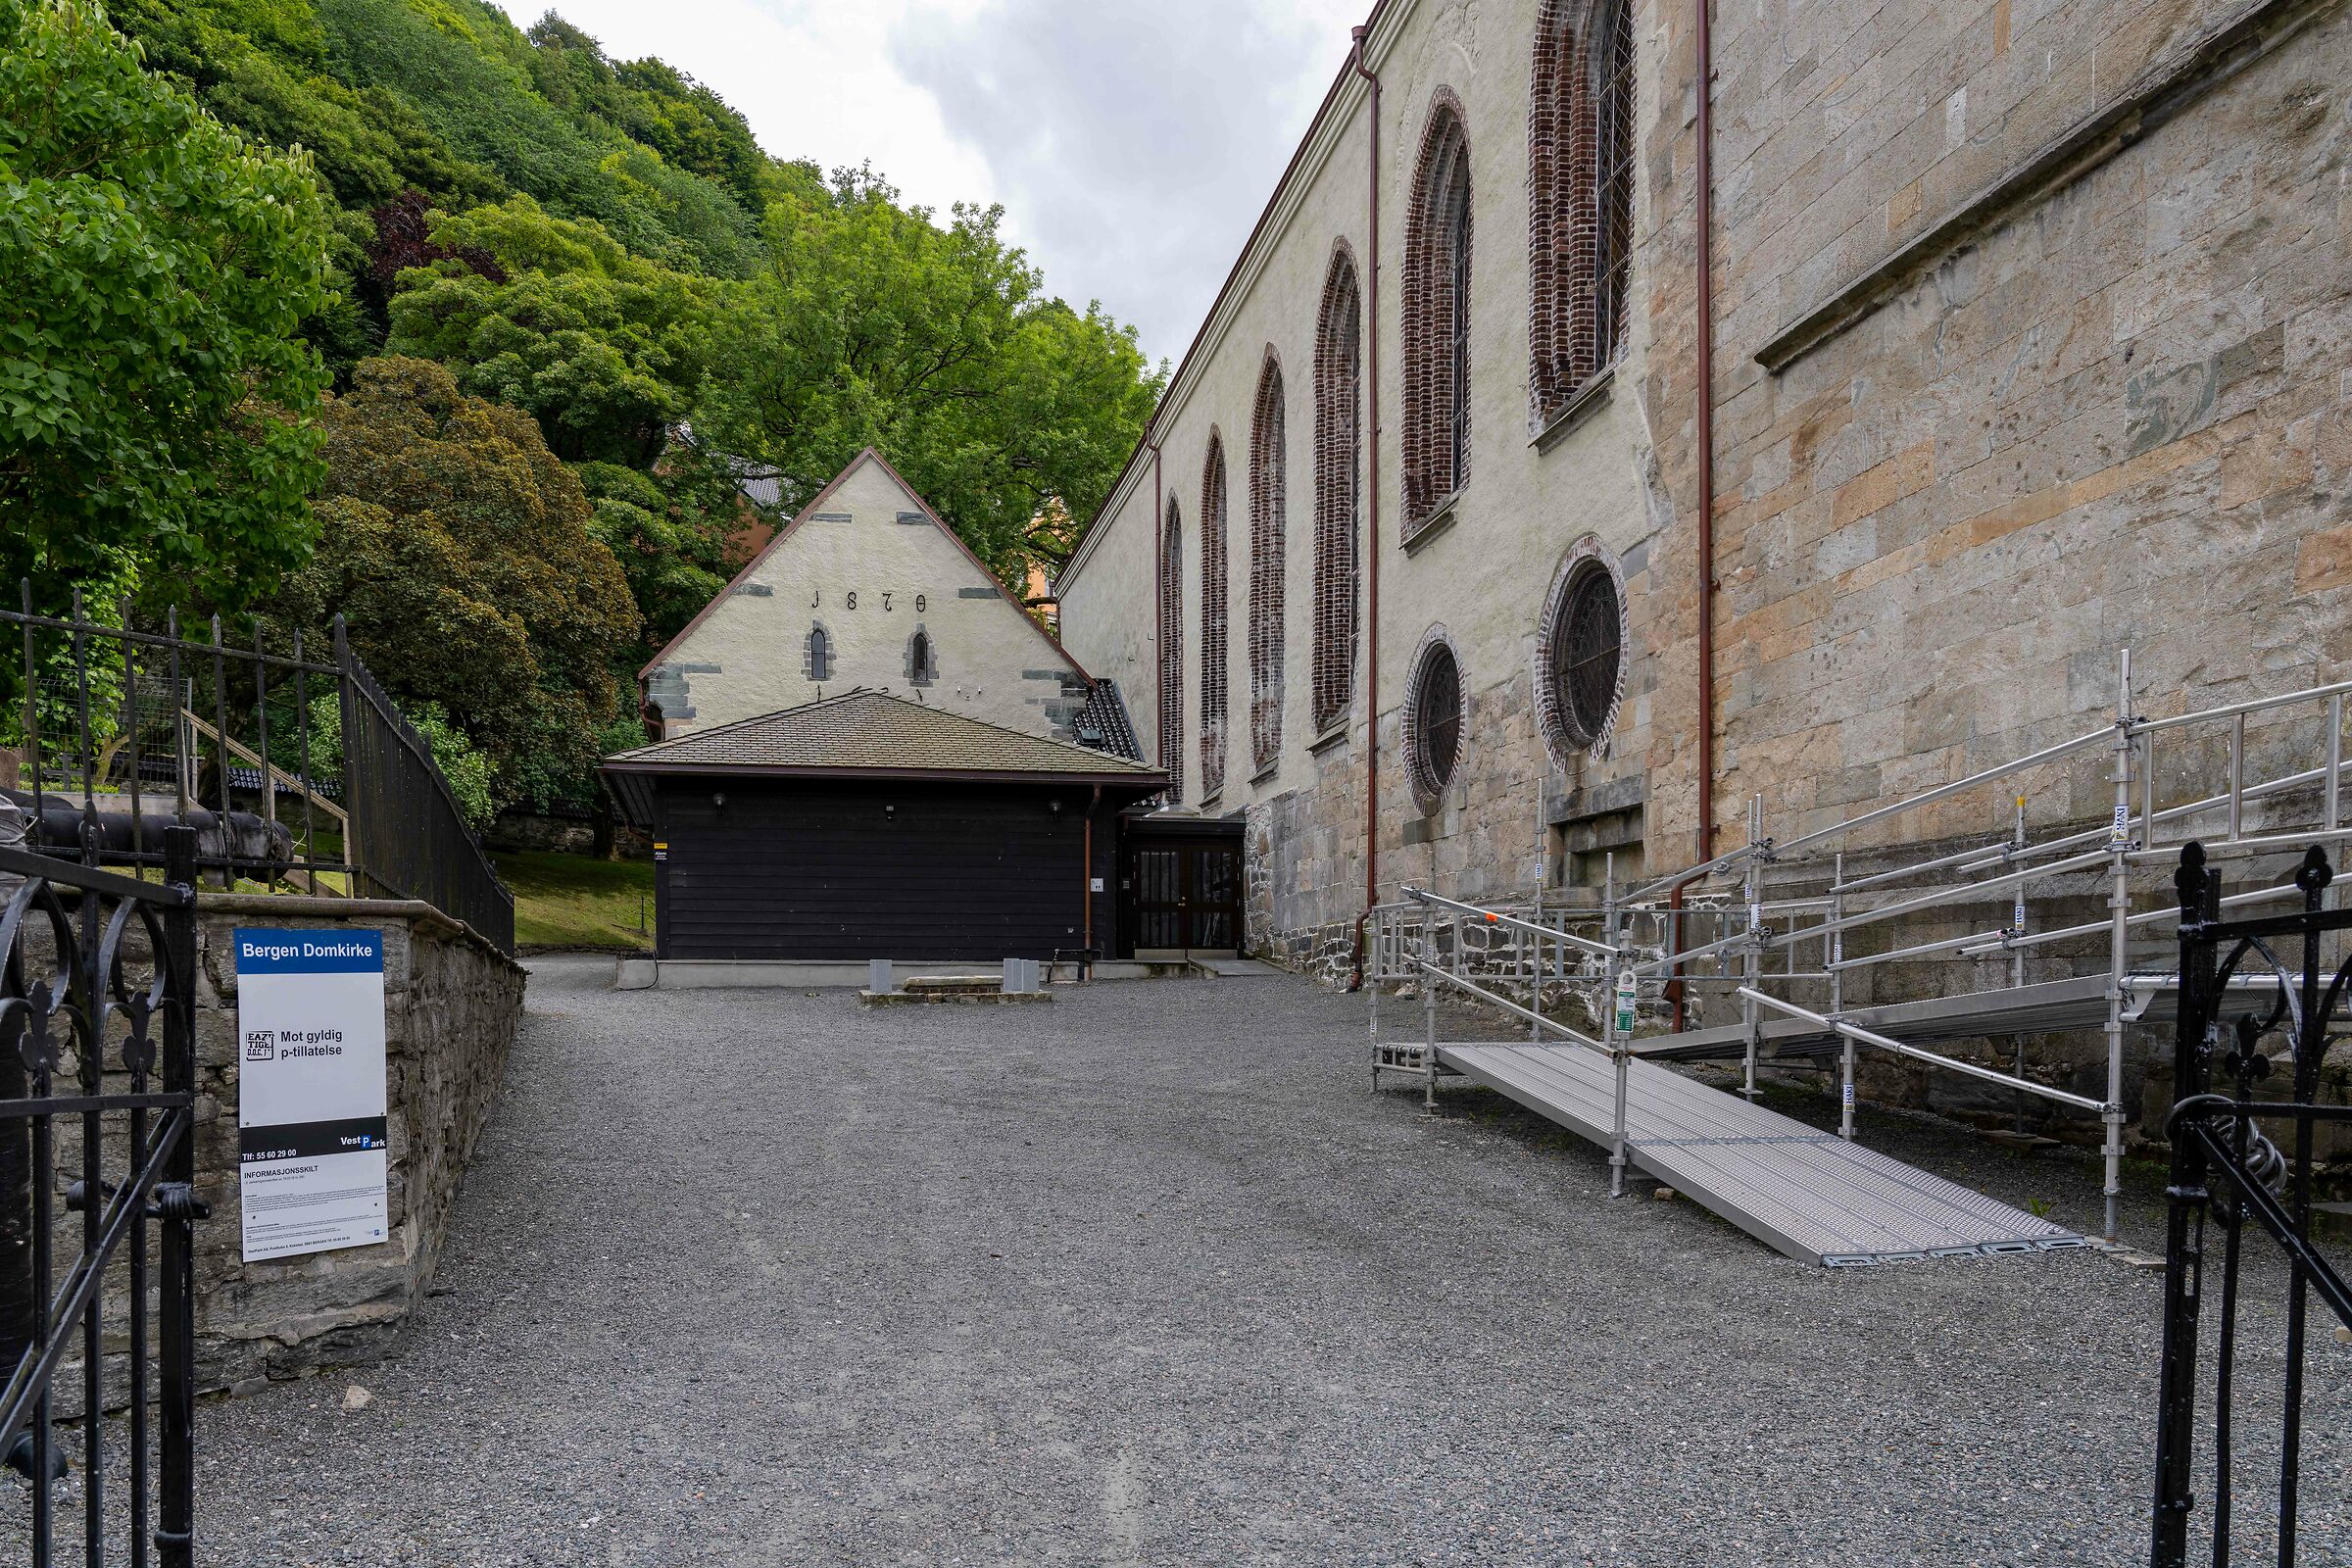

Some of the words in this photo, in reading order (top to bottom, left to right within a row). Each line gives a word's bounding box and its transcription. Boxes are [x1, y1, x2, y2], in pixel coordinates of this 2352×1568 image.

[242, 943, 299, 960] Bergen
[303, 943, 372, 957] Domkirke
[280, 1031, 304, 1043] Mot
[306, 1029, 343, 1044] gyldig
[281, 1045, 343, 1060] p-tillatelse
[276, 1150, 286, 1158] 29
[244, 1165, 318, 1179] INFORMASJONSSKILT
